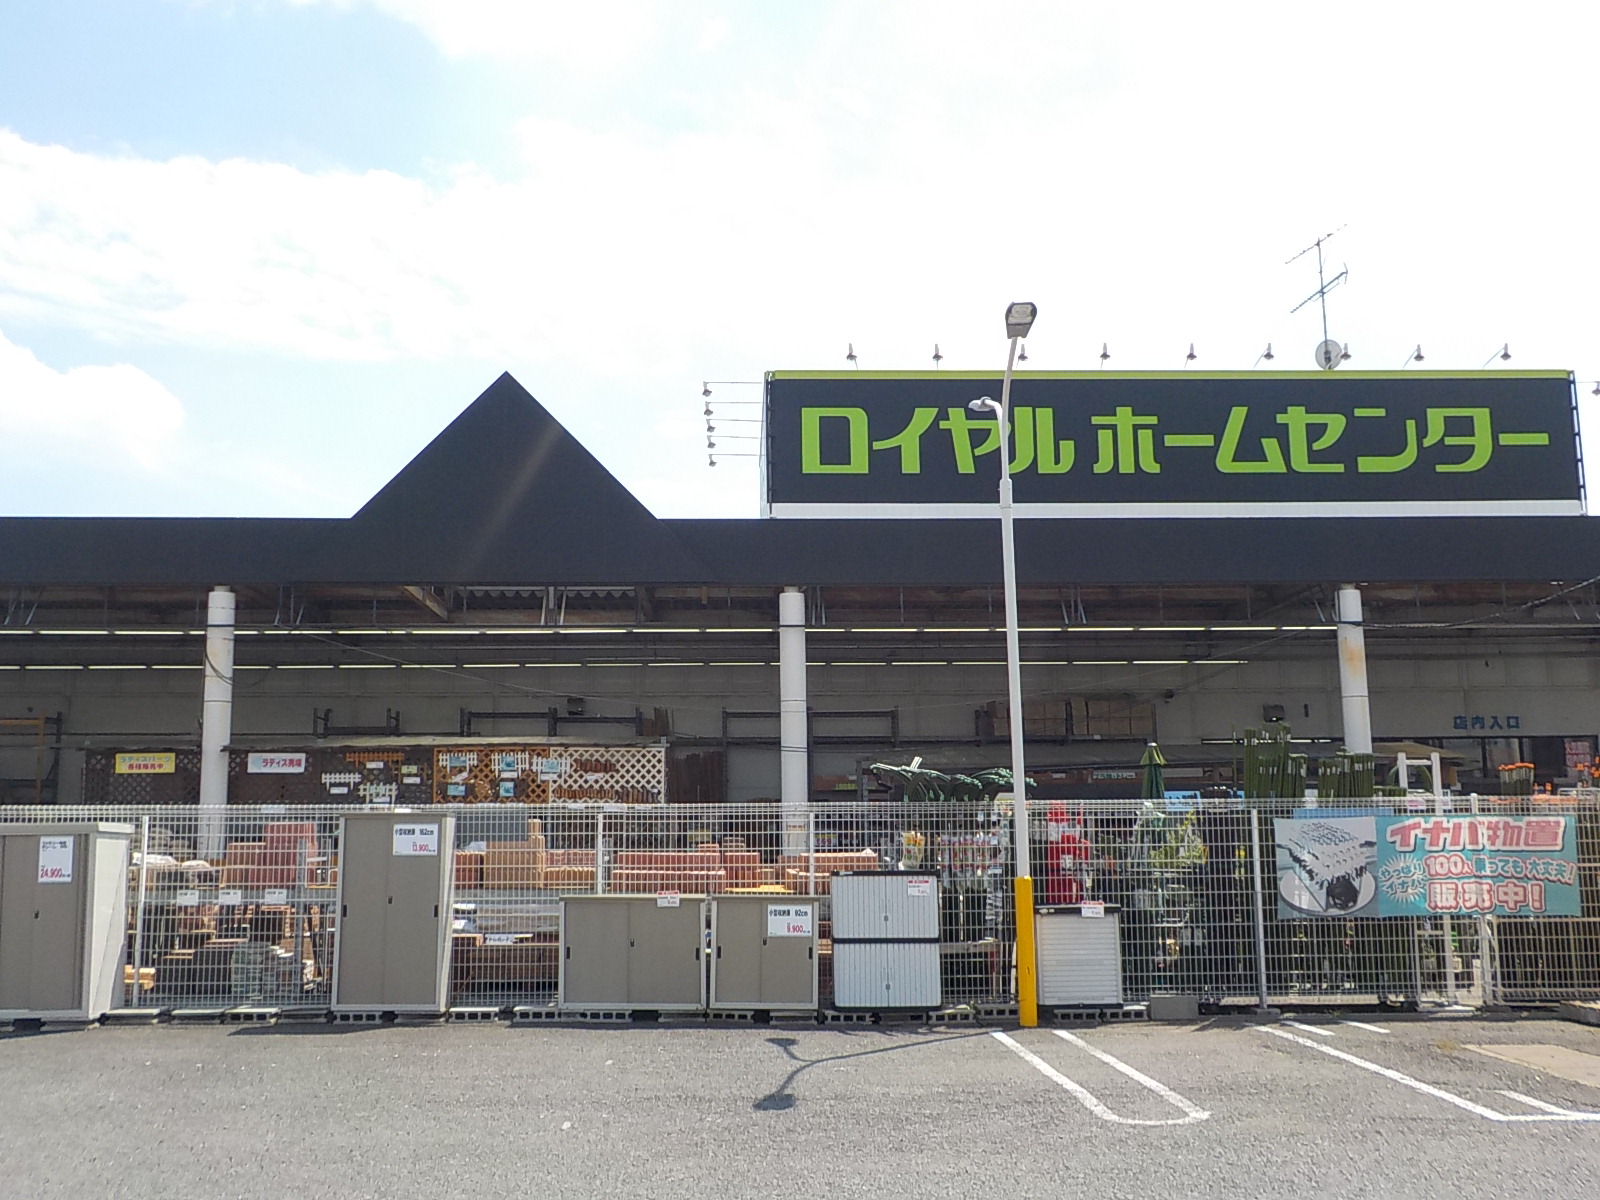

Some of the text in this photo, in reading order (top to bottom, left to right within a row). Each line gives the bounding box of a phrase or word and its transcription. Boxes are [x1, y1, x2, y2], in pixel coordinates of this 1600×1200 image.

[801, 405, 1550, 475] ロイヤルホームセンター
[1453, 715, 1521, 731] 店内入口
[261, 757, 303, 769] ラティス売場
[1388, 818, 1563, 848] イナバ物置
[1380, 862, 1423, 878] やっぱり
[1428, 881, 1543, 911] 販売中!
